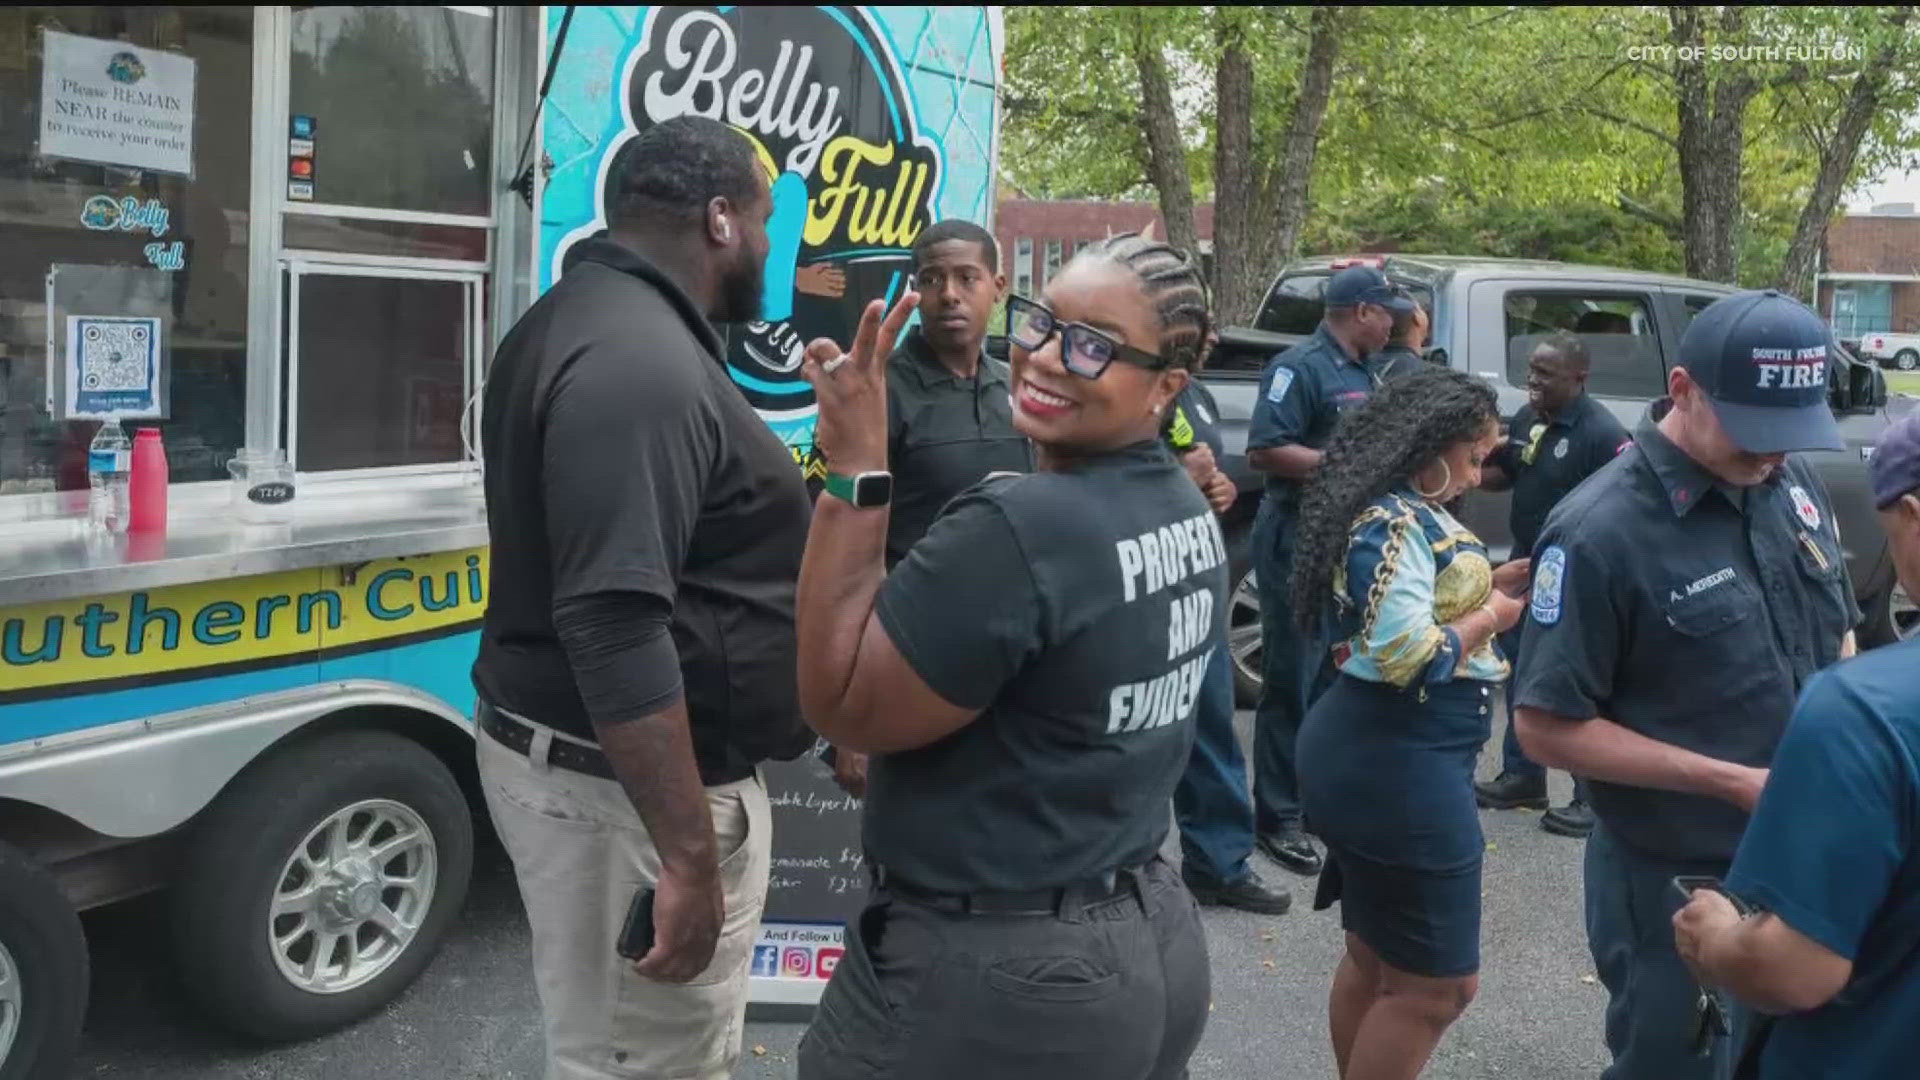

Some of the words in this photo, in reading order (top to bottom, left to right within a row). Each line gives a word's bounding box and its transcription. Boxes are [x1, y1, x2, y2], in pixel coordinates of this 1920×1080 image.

[61, 78, 108, 98] Please
[112, 86, 180, 111] REMAIN
[645, 10, 842, 179] Belly
[55, 100, 107, 120] NEAR
[112, 111, 134, 123] the
[137, 117, 184, 132] counter
[47, 120, 62, 131] to
[66, 123, 116, 139] receive
[120, 130, 151, 146] your
[154, 135, 186, 150] order
[803, 136, 927, 247] Full
[120, 196, 170, 237] Belly
[143, 241, 185, 271] Full
[1756, 361, 1825, 388] FIRE
[258, 487, 287, 498] TIPS
[2, 591, 342, 666] uthern
[365, 555, 482, 621] Cui
[1167, 588, 1214, 661] AND
[764, 930, 788, 940] And
[792, 931, 830, 942] Follow
